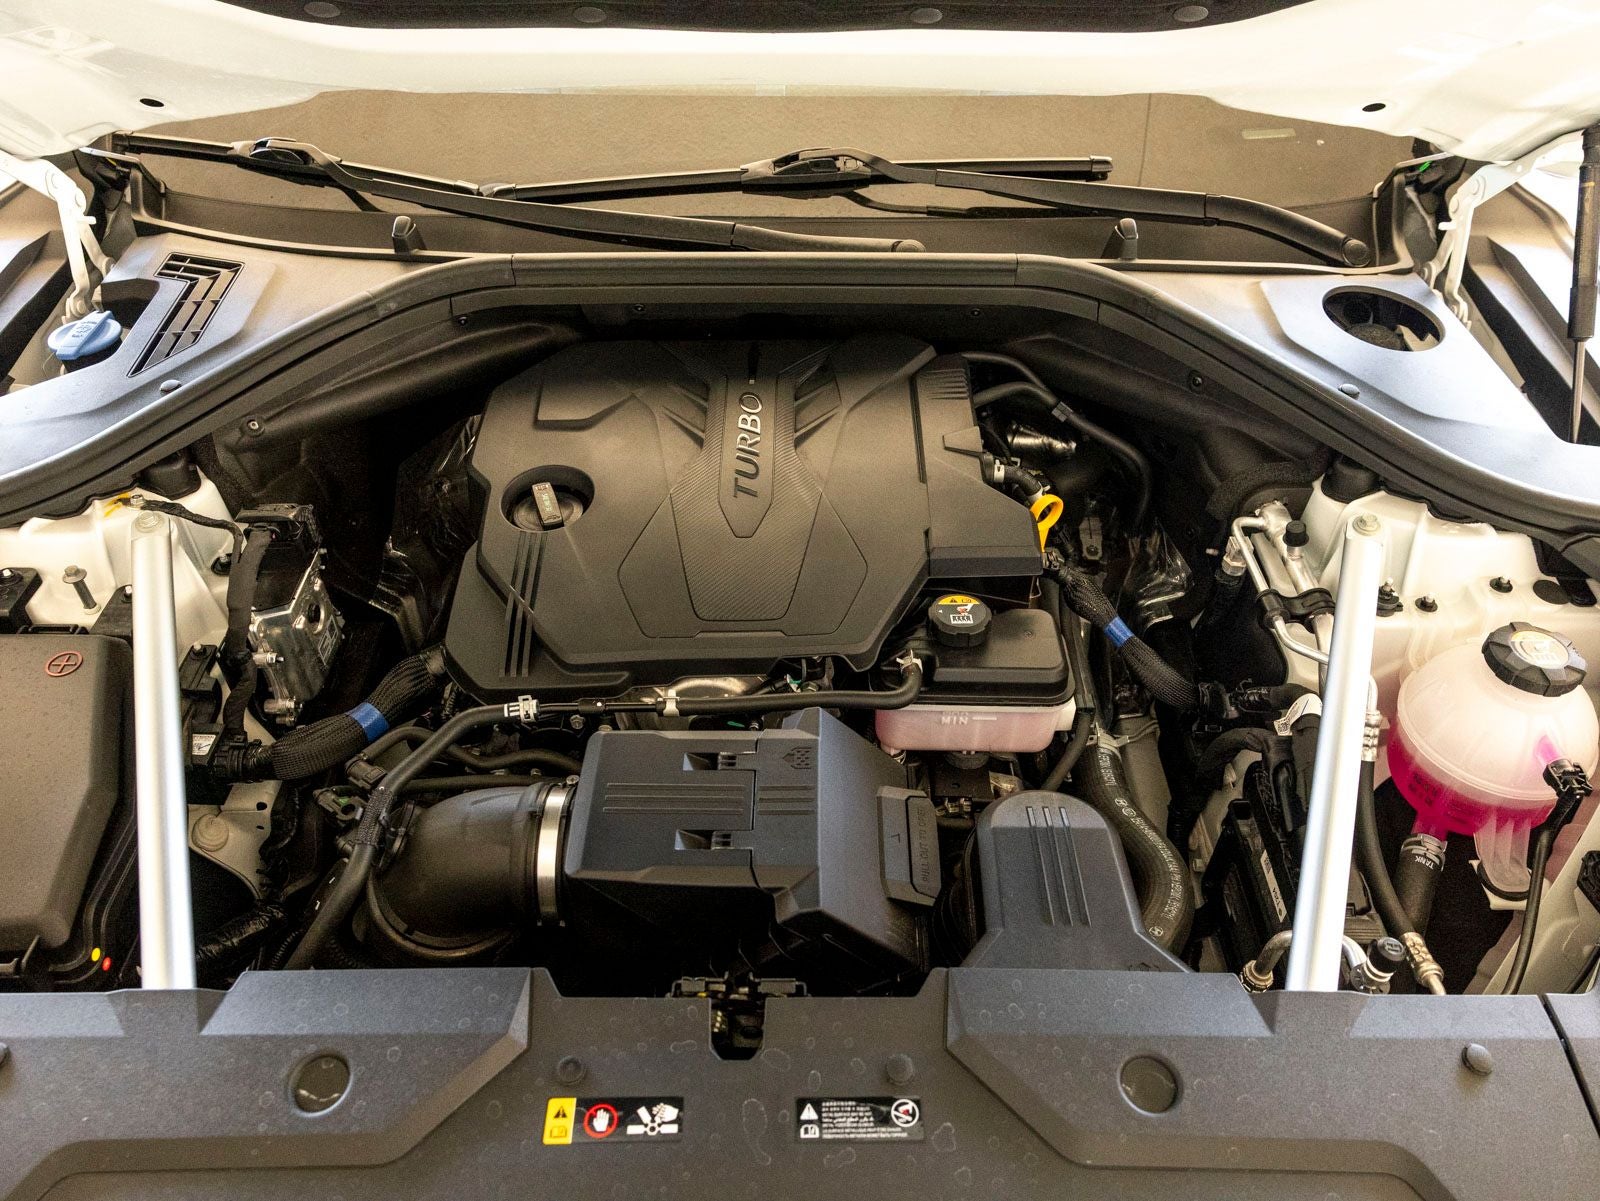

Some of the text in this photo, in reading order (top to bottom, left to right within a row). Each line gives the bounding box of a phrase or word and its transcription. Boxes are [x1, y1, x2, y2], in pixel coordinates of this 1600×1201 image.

[733, 391, 763, 499] TURBO
[941, 715, 969, 725] MIN
[1414, 855, 1435, 870] TANK
